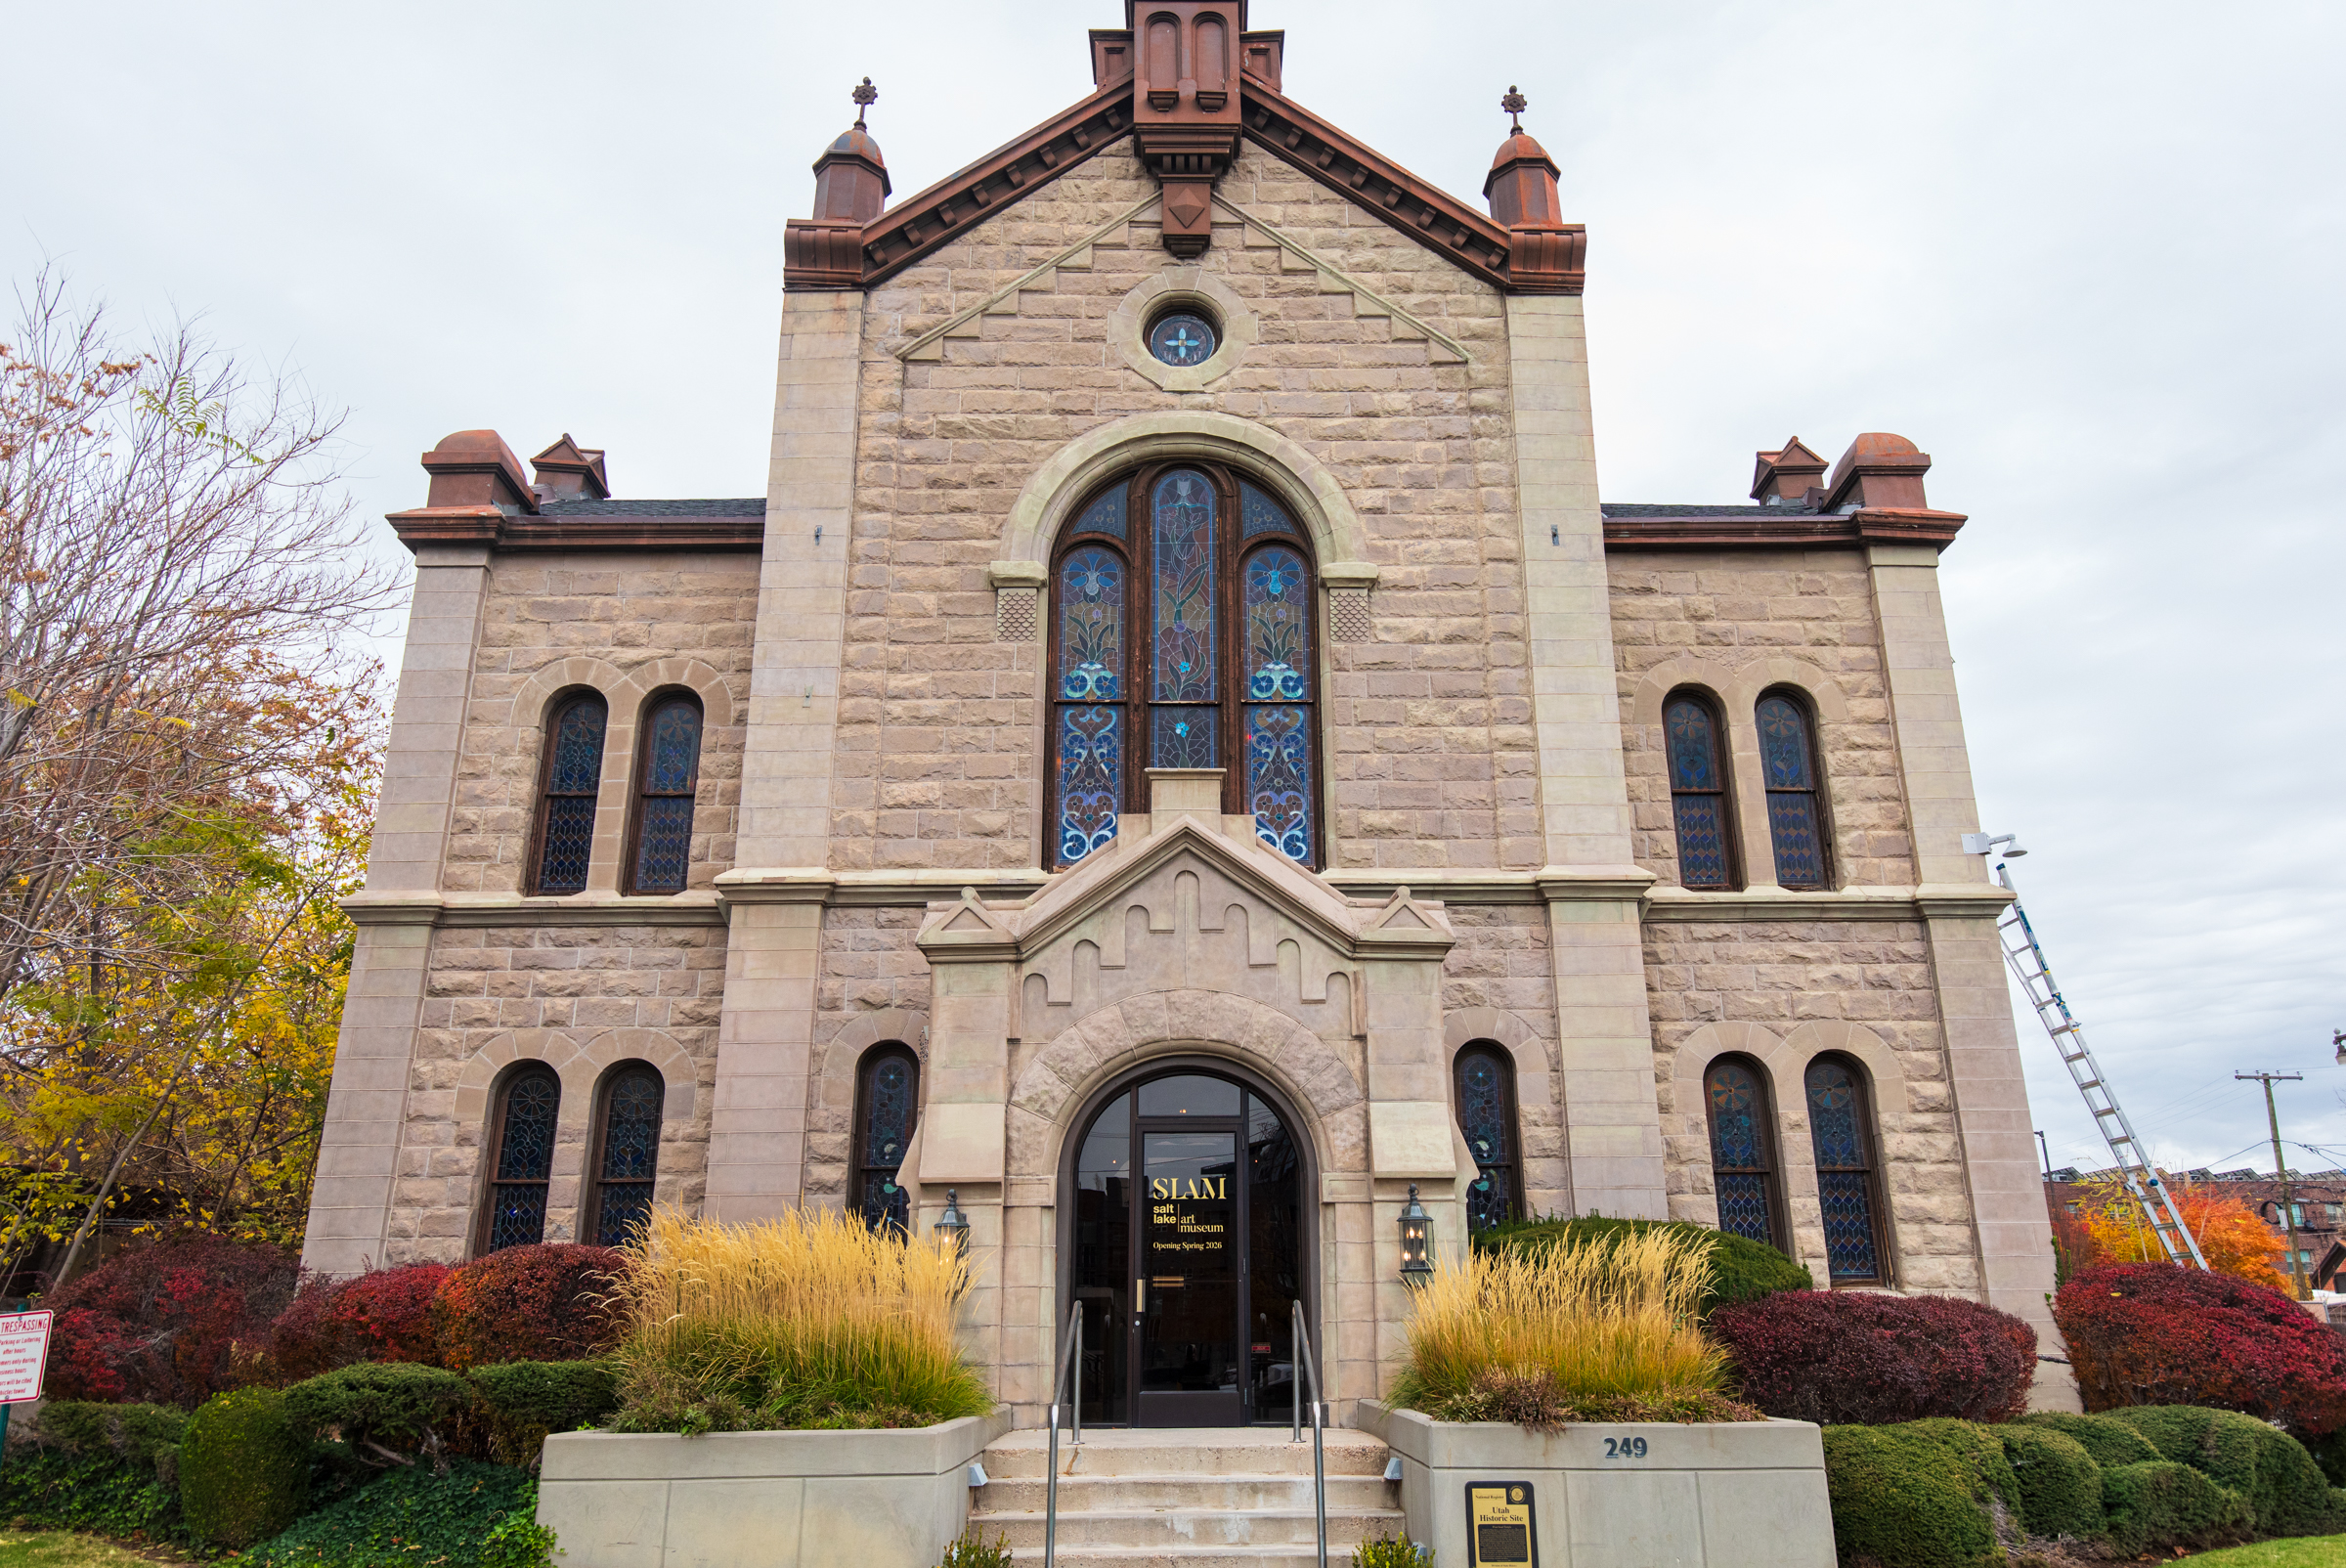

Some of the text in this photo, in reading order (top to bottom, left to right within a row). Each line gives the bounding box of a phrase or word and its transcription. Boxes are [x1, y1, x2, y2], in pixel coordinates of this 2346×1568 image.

[1153, 1177, 1227, 1199] SLAM
[1153, 1203, 1174, 1213] salt
[1153, 1214, 1176, 1224] lake
[1181, 1214, 1195, 1224] art
[1181, 1224, 1224, 1233] museum
[1153, 1241, 1181, 1251] Opening
[1182, 1241, 1204, 1251] Spring
[1, 1318, 47, 1333] TRESPASSING
[1604, 1437, 1647, 1459] 249
